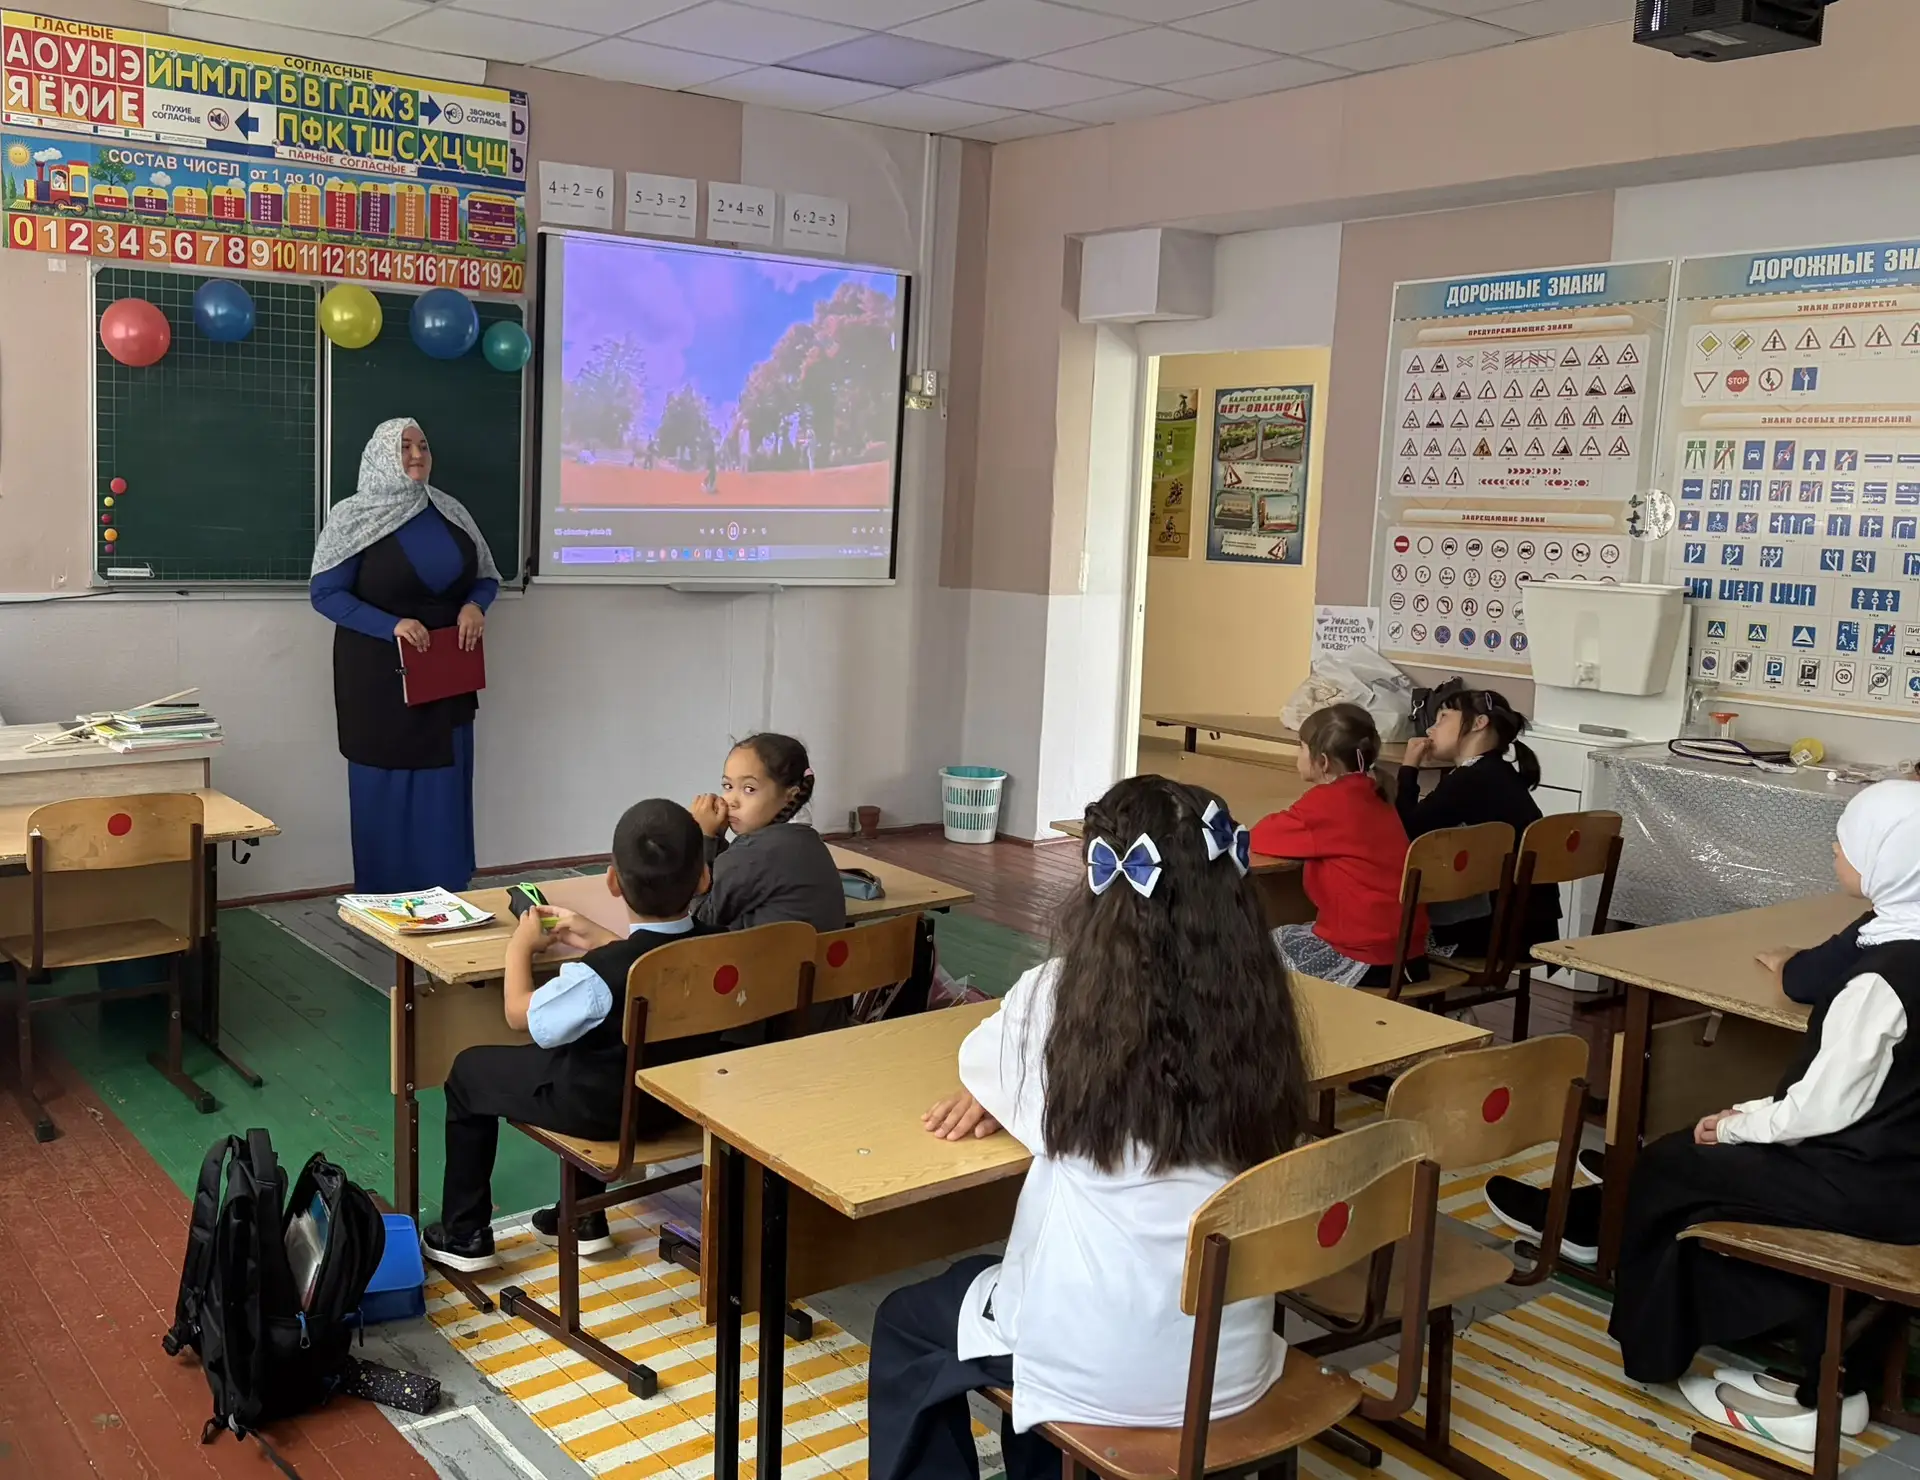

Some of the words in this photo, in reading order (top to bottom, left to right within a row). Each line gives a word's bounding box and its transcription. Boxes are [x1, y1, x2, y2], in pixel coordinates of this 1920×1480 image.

[34, 16, 114, 40] ГЛАСНЫЕ
[284, 57, 373, 80] СОГЛАСНЫЕ
[161, 104, 192, 114] ГЛУХИЕ
[470, 108, 500, 119] ЗВОНКИЕ
[152, 110, 201, 124] СОГЛАСНЫЕ
[467, 115, 507, 128] СОГЛАСНЫЕ
[108, 149, 177, 170] СОСТАВ
[183, 159, 240, 177] ЧИСЕЛ
[250, 170, 268, 180] от
[272, 169, 279, 181] 1
[284, 173, 304, 185] до
[309, 173, 324, 186] 10
[289, 150, 334, 164] ПАРНЫЕ
[340, 158, 406, 174] СОГЛАСНЫЕ
[107, 187, 113, 195] 1
[147, 188, 154, 196] 2
[225, 187, 233, 195] 4
[263, 184, 269, 192] 5
[338, 183, 344, 191] 7
[549, 181, 556, 194] 4
[572, 183, 580, 196] 2
[596, 186, 604, 199] 6
[635, 191, 642, 203] 5
[656, 193, 664, 206] 3
[678, 195, 686, 208] 2
[717, 199, 725, 212] 2
[736, 201, 743, 214] 4
[757, 204, 764, 217] 8
[793, 210, 800, 222] 6
[809, 211, 816, 224] 2
[828, 214, 836, 226] 3
[13, 216, 34, 240] 0
[43, 220, 57, 249] 1
[69, 223, 89, 251] 2
[97, 225, 115, 254] 3
[120, 227, 140, 256] 4
[148, 229, 168, 258] 5
[174, 232, 194, 261] 6
[201, 235, 220, 263] 7
[227, 237, 246, 265] 8
[250, 239, 270, 267] 9
[273, 242, 296, 270] 10
[300, 245, 318, 272] 11
[322, 246, 345, 275] 12
[347, 249, 368, 276] 13
[370, 250, 392, 279] 14
[394, 253, 415, 280] 15
[416, 255, 437, 282] 16
[438, 257, 458, 284] 17
[460, 259, 480, 287] 18
[482, 262, 501, 288] 19
[503, 264, 523, 290] 20
[1749, 250, 1875, 284] ДОРОЖНЫЕ
[1447, 278, 1541, 307] ДОРОЖНЫЕ
[1548, 272, 1606, 297] ЗНАКИ
[1797, 303, 1829, 312] ЗНАКИ
[1832, 300, 1897, 310] ПРИОРИТЕТА
[1468, 324, 1545, 336] ПРЕДУПРЕЖДАЮЩИЕ
[1547, 323, 1573, 332] ЗНАКИ
[1727, 377, 1747, 385] STOP
[1761, 416, 1792, 424] ЗНАКИ
[1795, 416, 1835, 424] ОСОБЫХ
[1838, 415, 1912, 424] ПРЕДПИСАНИЙ
[1462, 514, 1519, 522] ЗАПРЕЩАЮЩИЕ
[1324, 626, 1366, 634] ИНТЕРЕСНО
